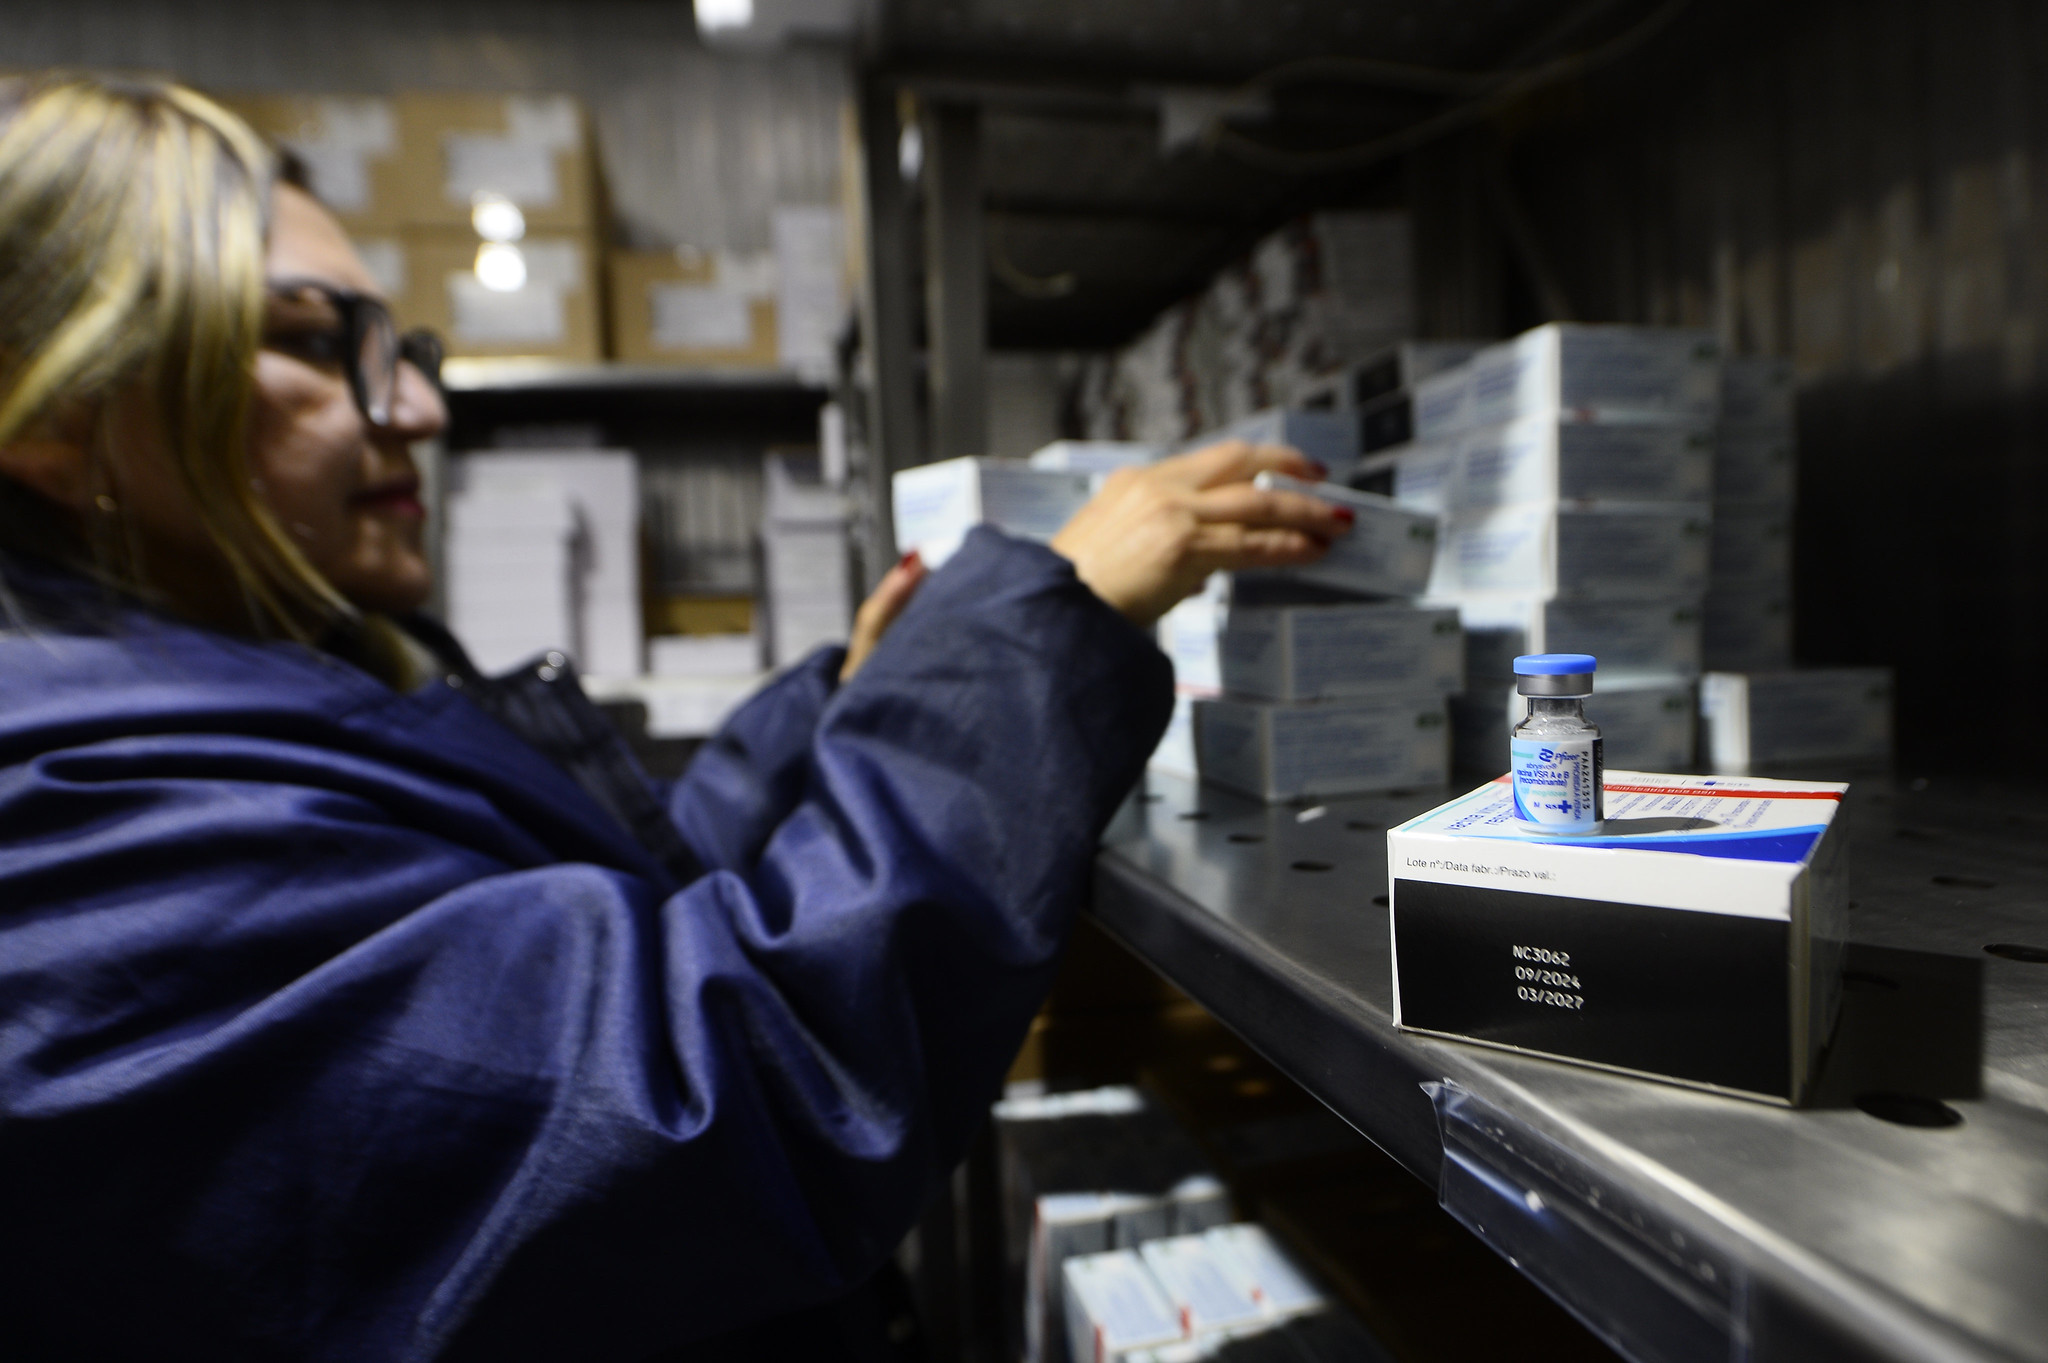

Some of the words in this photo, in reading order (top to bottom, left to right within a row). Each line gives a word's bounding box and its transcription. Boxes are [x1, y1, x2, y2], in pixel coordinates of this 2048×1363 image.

[1555, 751, 1580, 764] Pfizer
[1533, 770, 1549, 778] VSR
[1564, 771, 1569, 779] B
[1406, 857, 1427, 867] Lote
[1512, 944, 1570, 967] NC3062
[1514, 965, 1582, 990] 09/2024
[1517, 985, 1584, 1010] 03/2027
